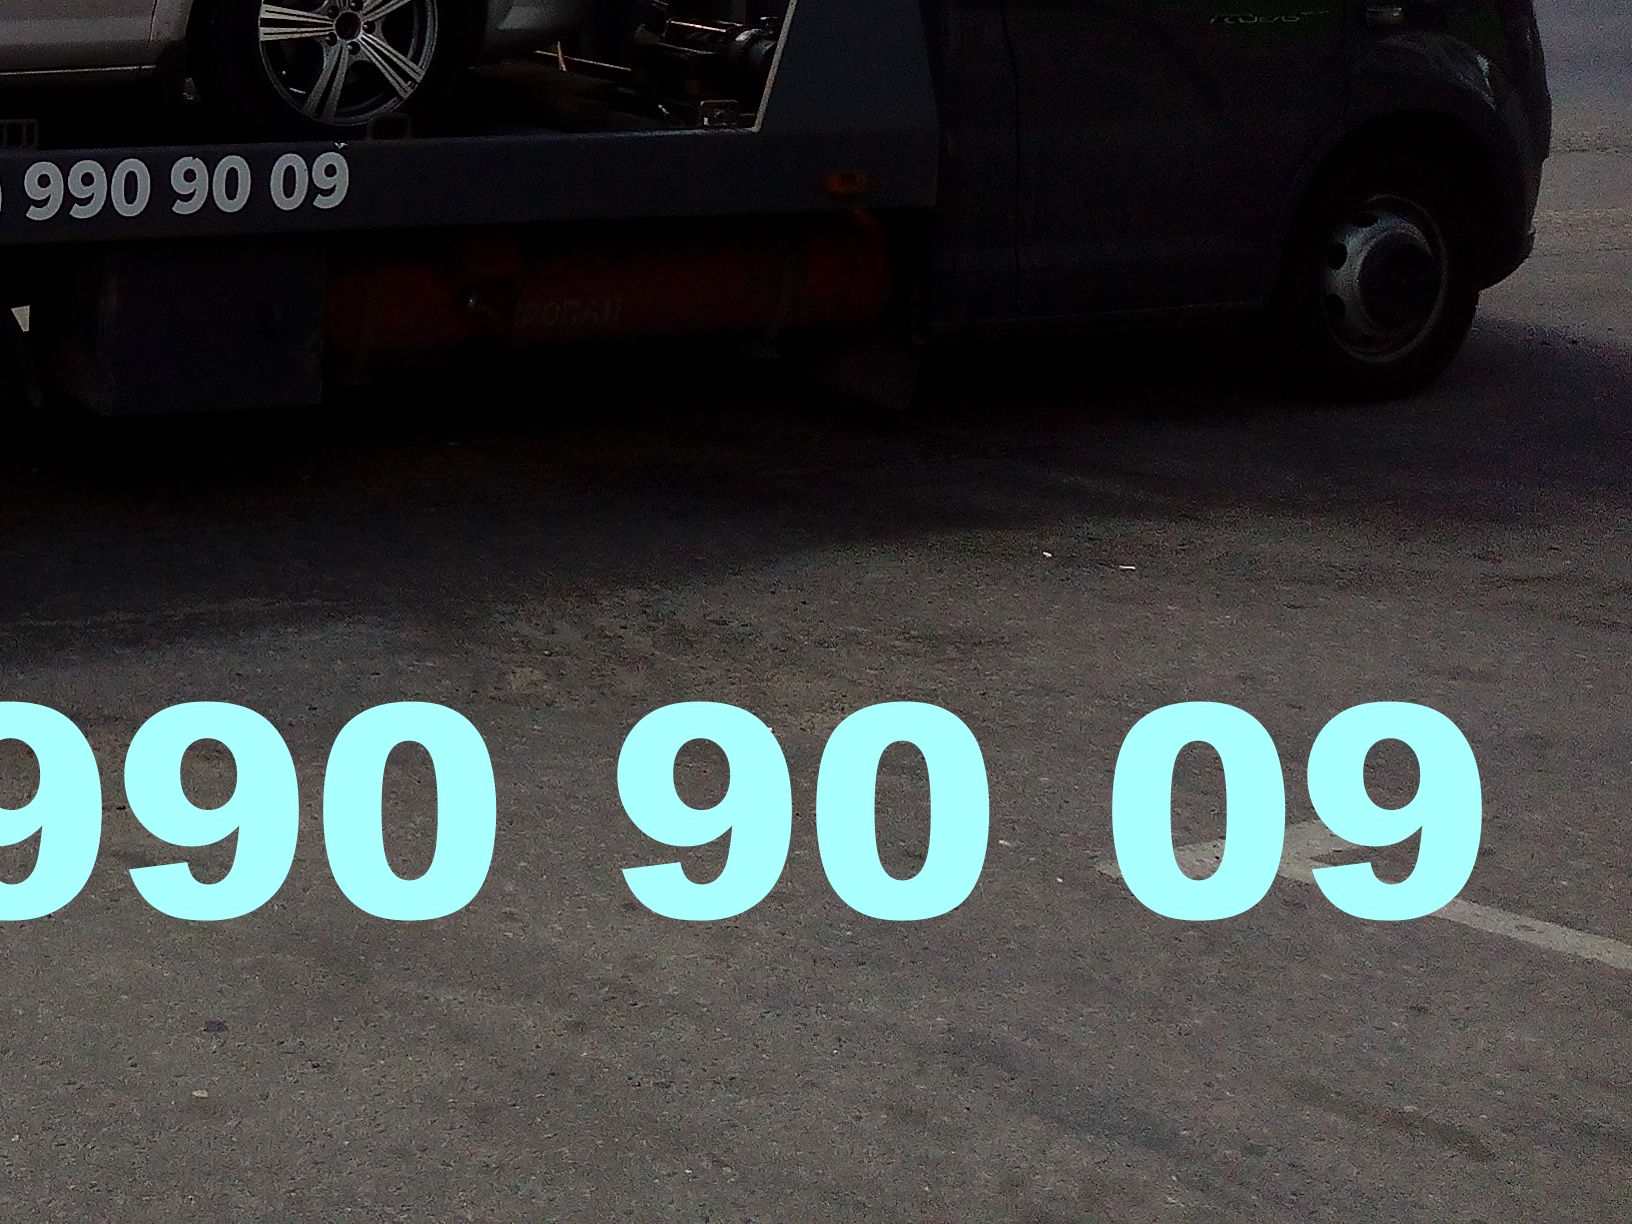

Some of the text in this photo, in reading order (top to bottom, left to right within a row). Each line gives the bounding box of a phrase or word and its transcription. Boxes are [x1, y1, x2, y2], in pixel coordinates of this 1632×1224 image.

[23, 158, 151, 221] 990
[170, 155, 252, 215] 90
[269, 151, 349, 211] 09
